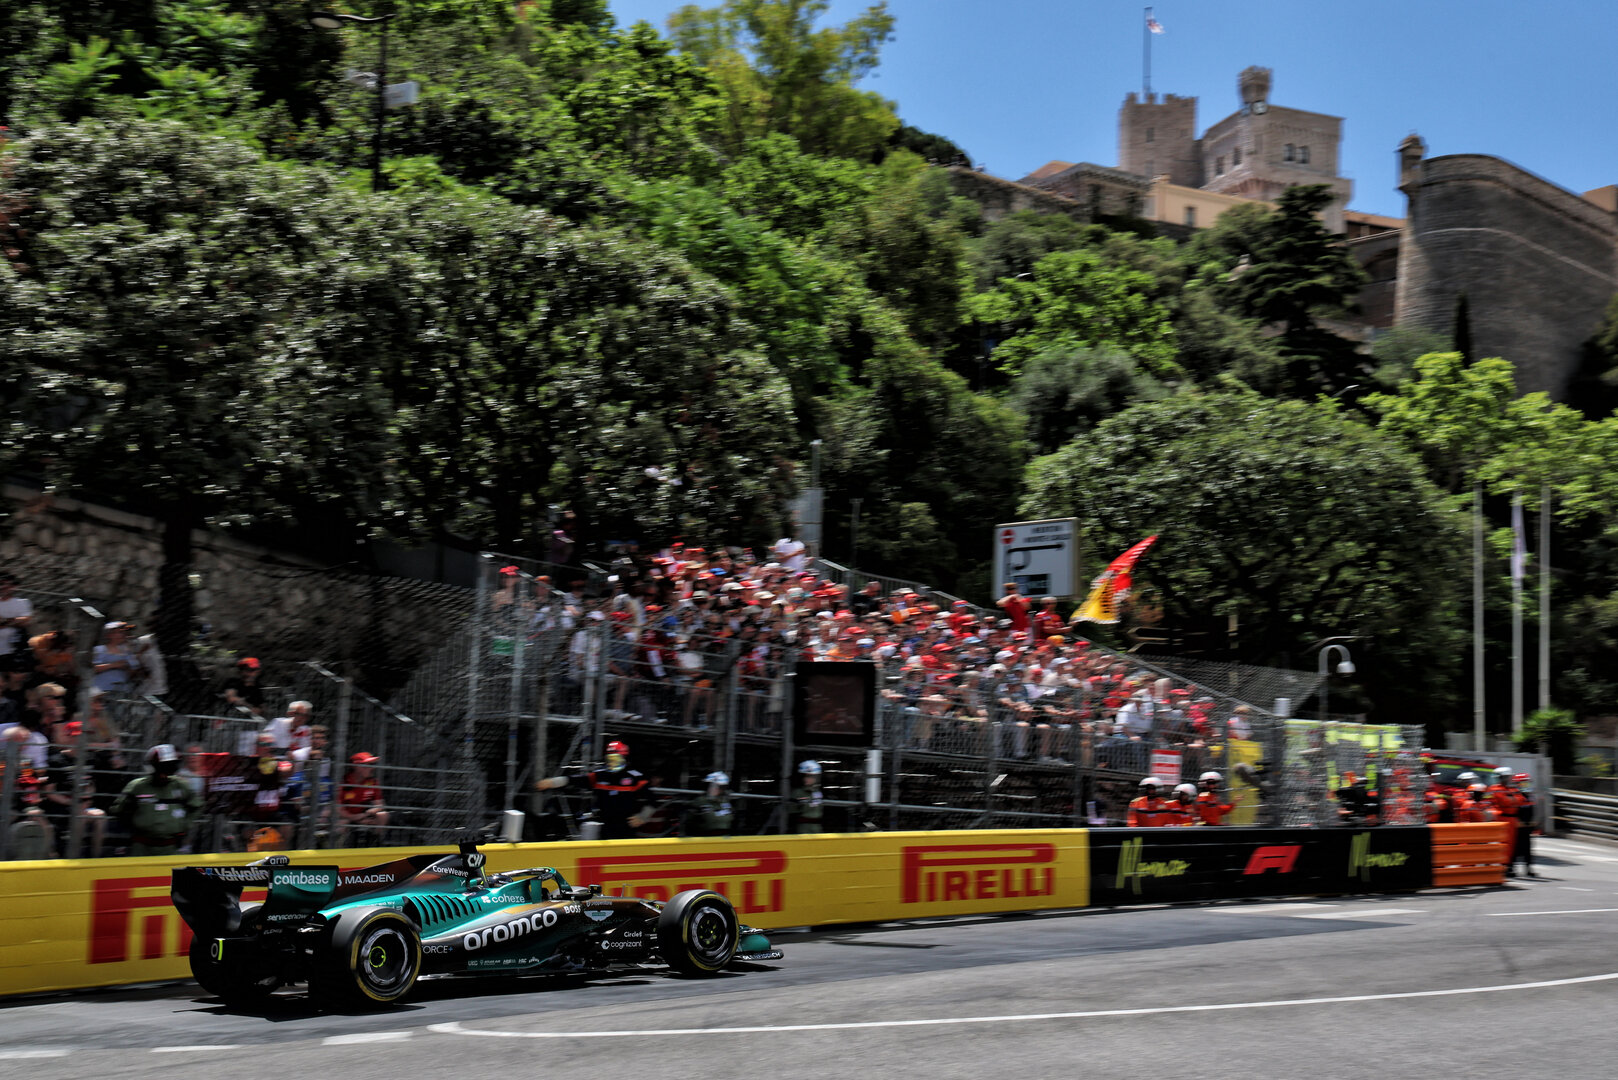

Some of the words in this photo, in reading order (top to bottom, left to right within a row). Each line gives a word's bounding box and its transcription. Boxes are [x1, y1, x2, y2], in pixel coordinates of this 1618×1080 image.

[269, 856, 288, 865] arm
[214, 867, 269, 882] Valvolin
[432, 865, 469, 877] CoreWeave
[901, 843, 1057, 903] PIRELLI
[274, 872, 329, 885] coinbase
[345, 873, 395, 885] MAADEN
[491, 894, 526, 904] cohere
[563, 904, 581, 914] BOSS
[267, 914, 308, 922] servicenow
[463, 909, 558, 951] aramco
[610, 940, 642, 949] cognizant
